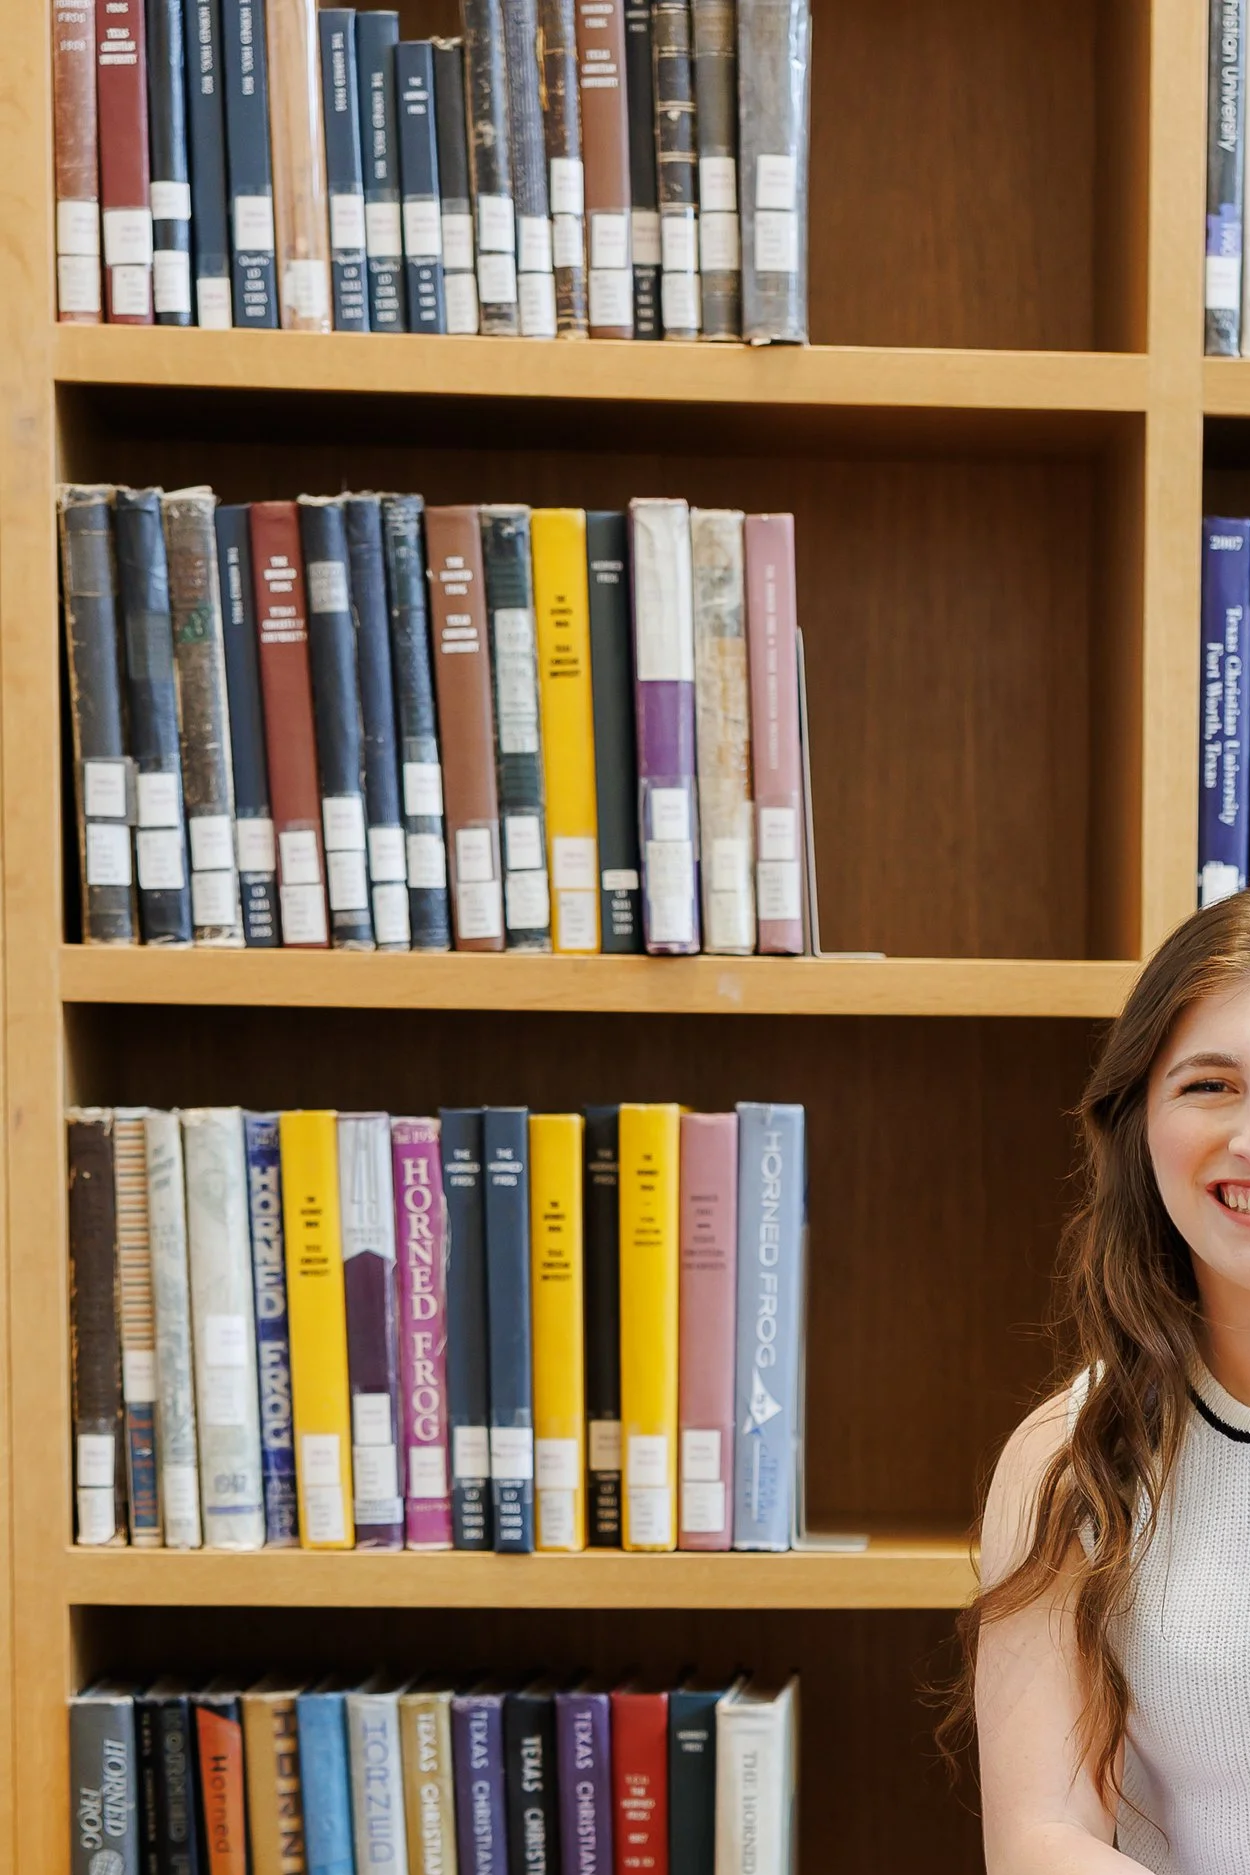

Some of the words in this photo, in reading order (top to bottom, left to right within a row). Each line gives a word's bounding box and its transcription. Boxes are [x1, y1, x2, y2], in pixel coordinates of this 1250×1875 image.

[1217, 66, 1240, 153] University
[1207, 642, 1226, 680] Fort
[1227, 605, 1244, 653] Texas
[1205, 683, 1224, 741] Worth,
[1225, 655, 1244, 736] Christian
[1204, 742, 1222, 790] Texas
[1219, 739, 1242, 827] University
[757, 1130, 785, 1266] HORNED
[250, 1165, 287, 1320] HORNED
[402, 1157, 438, 1321] HORNED
[754, 1272, 780, 1369] FROG
[258, 1341, 292, 1449] FROG
[412, 1332, 441, 1442] FROG
[417, 1712, 439, 1771] TEXAS
[470, 1710, 490, 1768] TEXAS
[521, 1735, 543, 1792] TEXAS
[574, 1711, 594, 1769] TEXAS
[742, 1750, 759, 1789] THE
[78, 1787, 102, 1850] FROG
[102, 1739, 135, 1837] HORNED
[209, 1755, 231, 1854] Horned
[742, 1795, 759, 1875] HORNED
